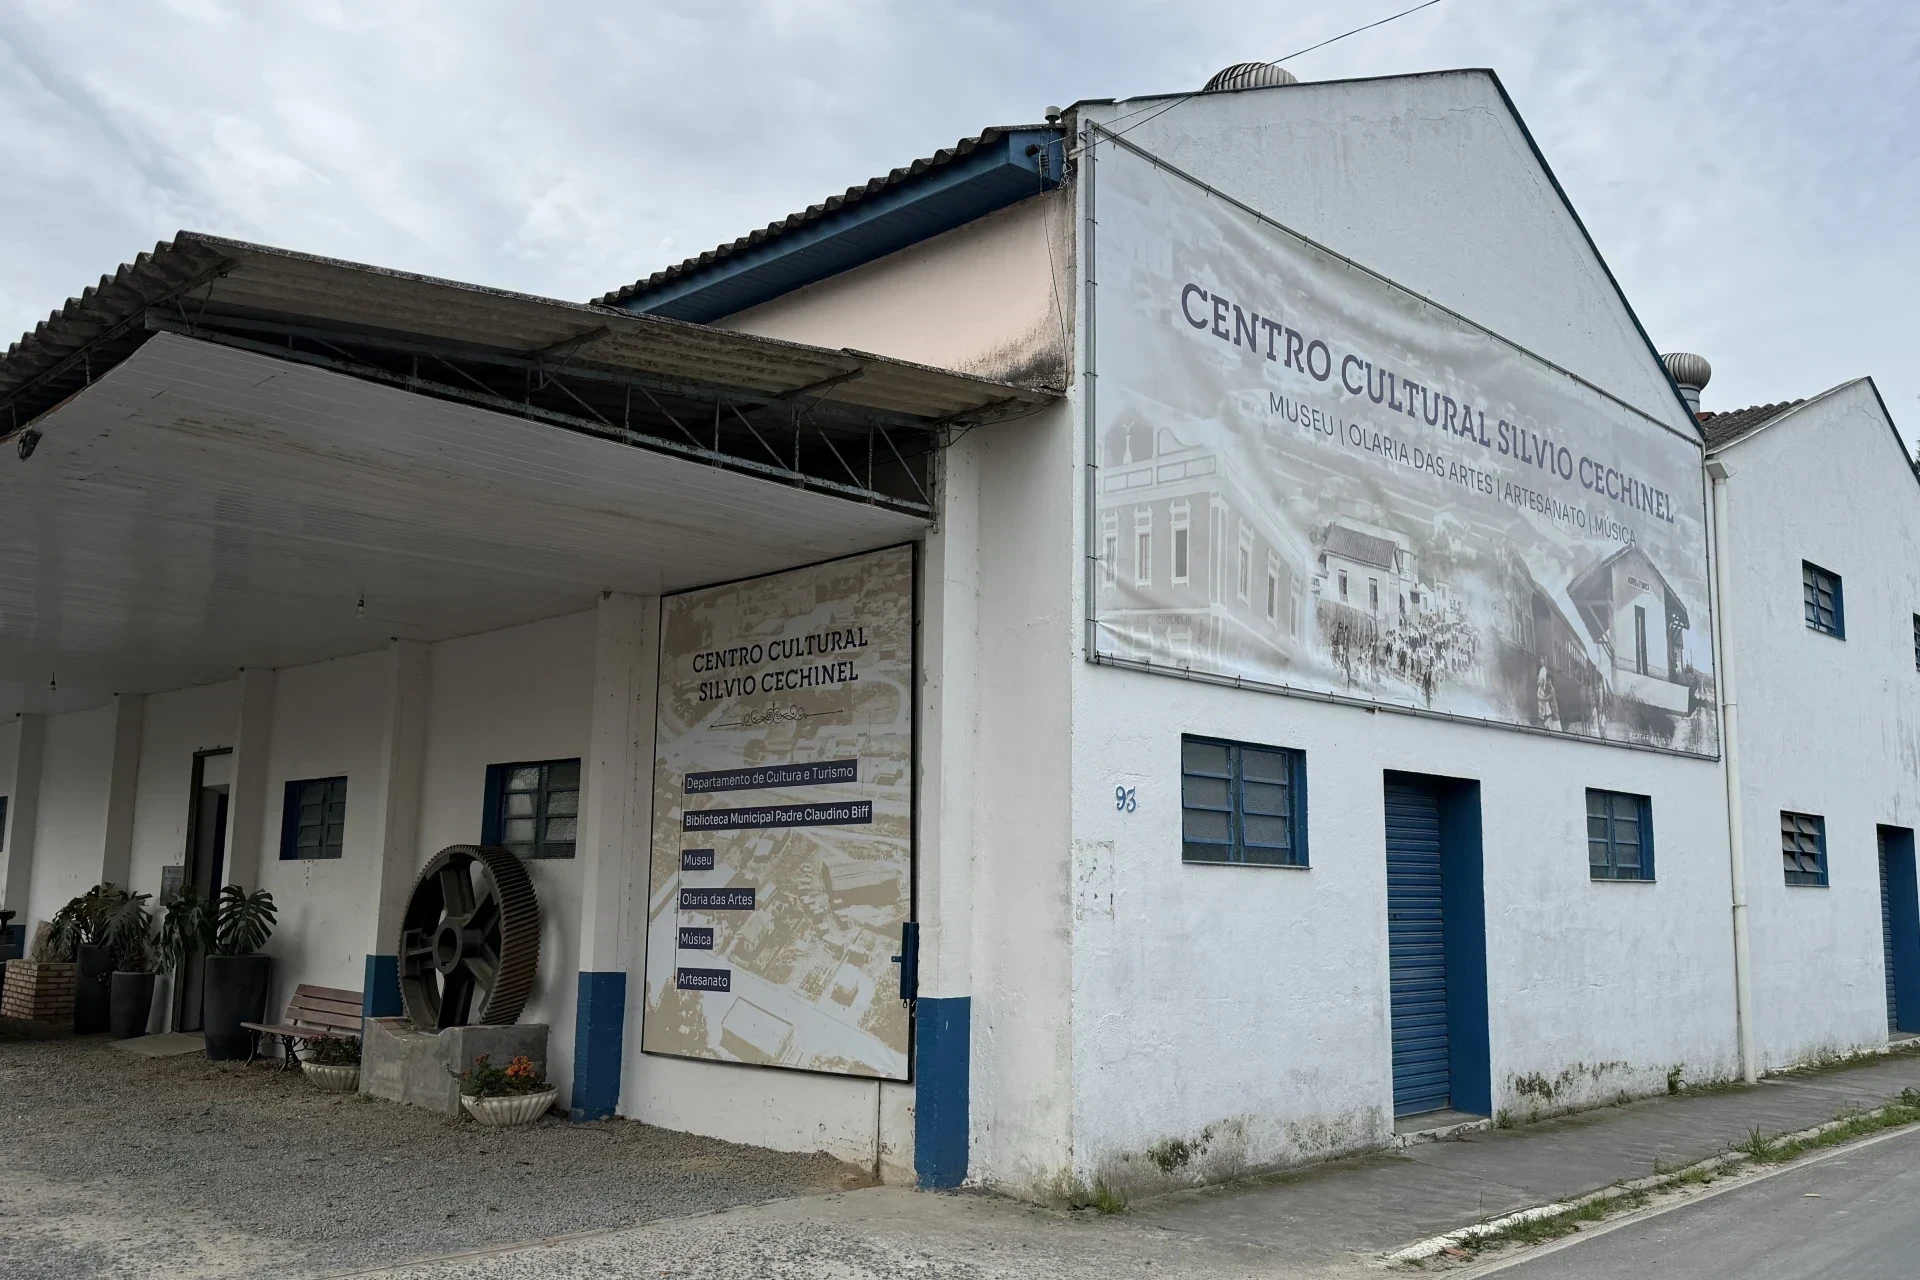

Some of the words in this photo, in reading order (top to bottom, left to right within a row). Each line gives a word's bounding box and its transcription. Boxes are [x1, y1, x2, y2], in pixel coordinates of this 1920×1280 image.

[1181, 283, 1331, 381] CENTRO
[1341, 354, 1491, 448] CULTURAL
[1497, 419, 1573, 480] SILVIO
[1579, 456, 1674, 524] CECHINEL
[1269, 391, 1334, 436] MUSEU
[1349, 423, 1410, 465] OLARIA
[1414, 447, 1445, 478] DAS
[1449, 461, 1493, 495] ARTES
[1504, 482, 1586, 528] ARTESANATO
[1595, 516, 1636, 545] MÚSICA
[692, 644, 763, 673] CENTRO
[768, 627, 868, 660] CULTURAL
[699, 676, 756, 702] SILVIO
[761, 661, 859, 692] CECHINEL
[686, 775, 750, 790] Departamento
[752, 773, 765, 784] de
[766, 770, 802, 783] Cultura
[803, 771, 810, 780] e
[812, 766, 854, 779] Turismo
[1115, 785, 1137, 813] 93
[686, 814, 729, 827] Biblioteca
[730, 811, 774, 826] Municipal
[775, 810, 803, 822] Padre
[804, 807, 850, 821] Claudino
[851, 805, 870, 818] Biff
[684, 854, 712, 866] Museu
[682, 893, 708, 905] Olaria
[710, 893, 726, 905] das
[728, 893, 753, 906] Artes
[681, 932, 711, 945] Música
[679, 973, 728, 987] Artesanato
